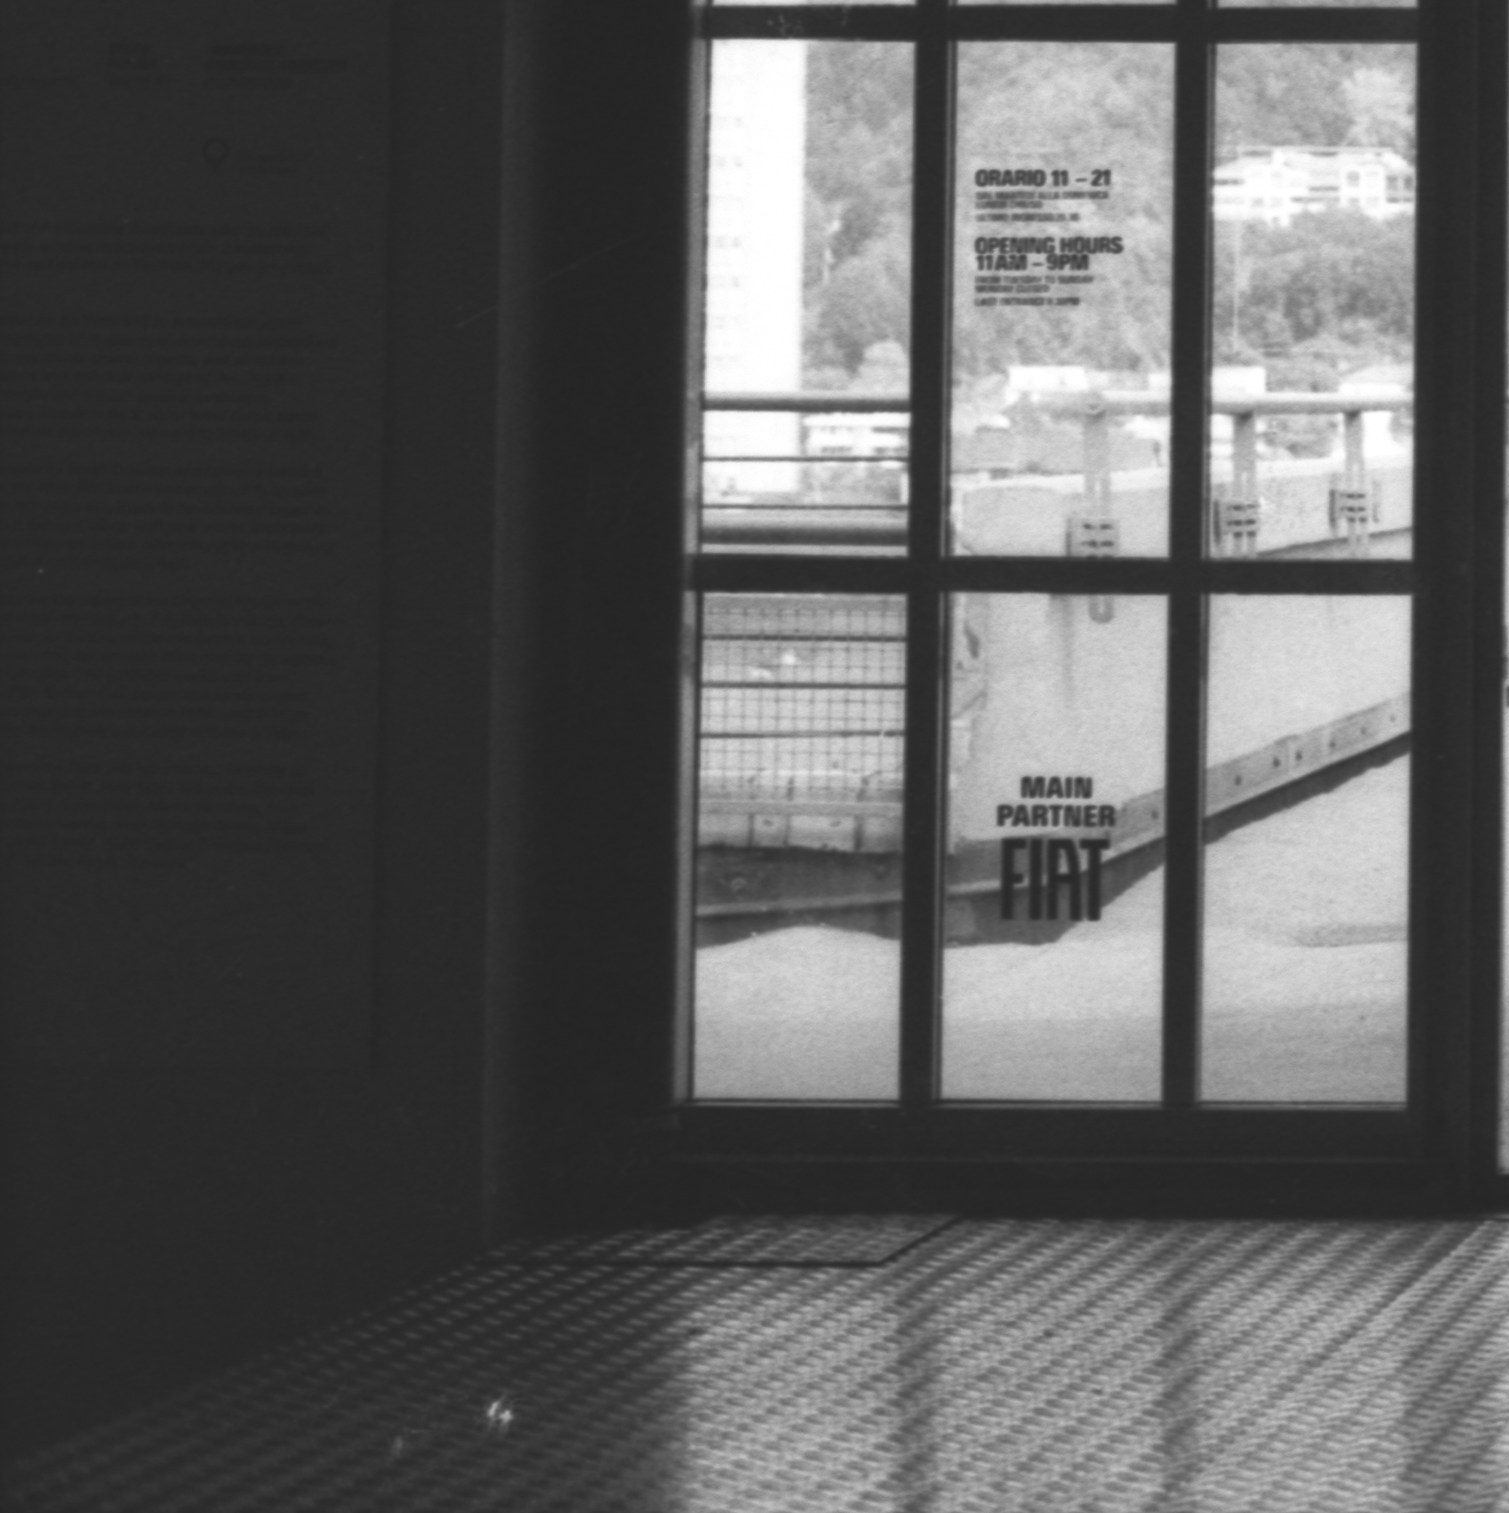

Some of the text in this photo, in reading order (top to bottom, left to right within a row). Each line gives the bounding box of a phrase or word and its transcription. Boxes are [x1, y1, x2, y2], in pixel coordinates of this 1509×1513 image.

[974, 169, 1046, 187] ORARIO
[1051, 169, 1069, 187] 11
[1090, 169, 1112, 187] 21
[974, 236, 1124, 254] OPENING HOURS
[976, 254, 1027, 271] 11AM
[1046, 253, 1090, 271] 9PM
[1020, 776, 1093, 799] MAIN
[996, 804, 1116, 827] PARTNER
[1000, 837, 1111, 922] FIAT
